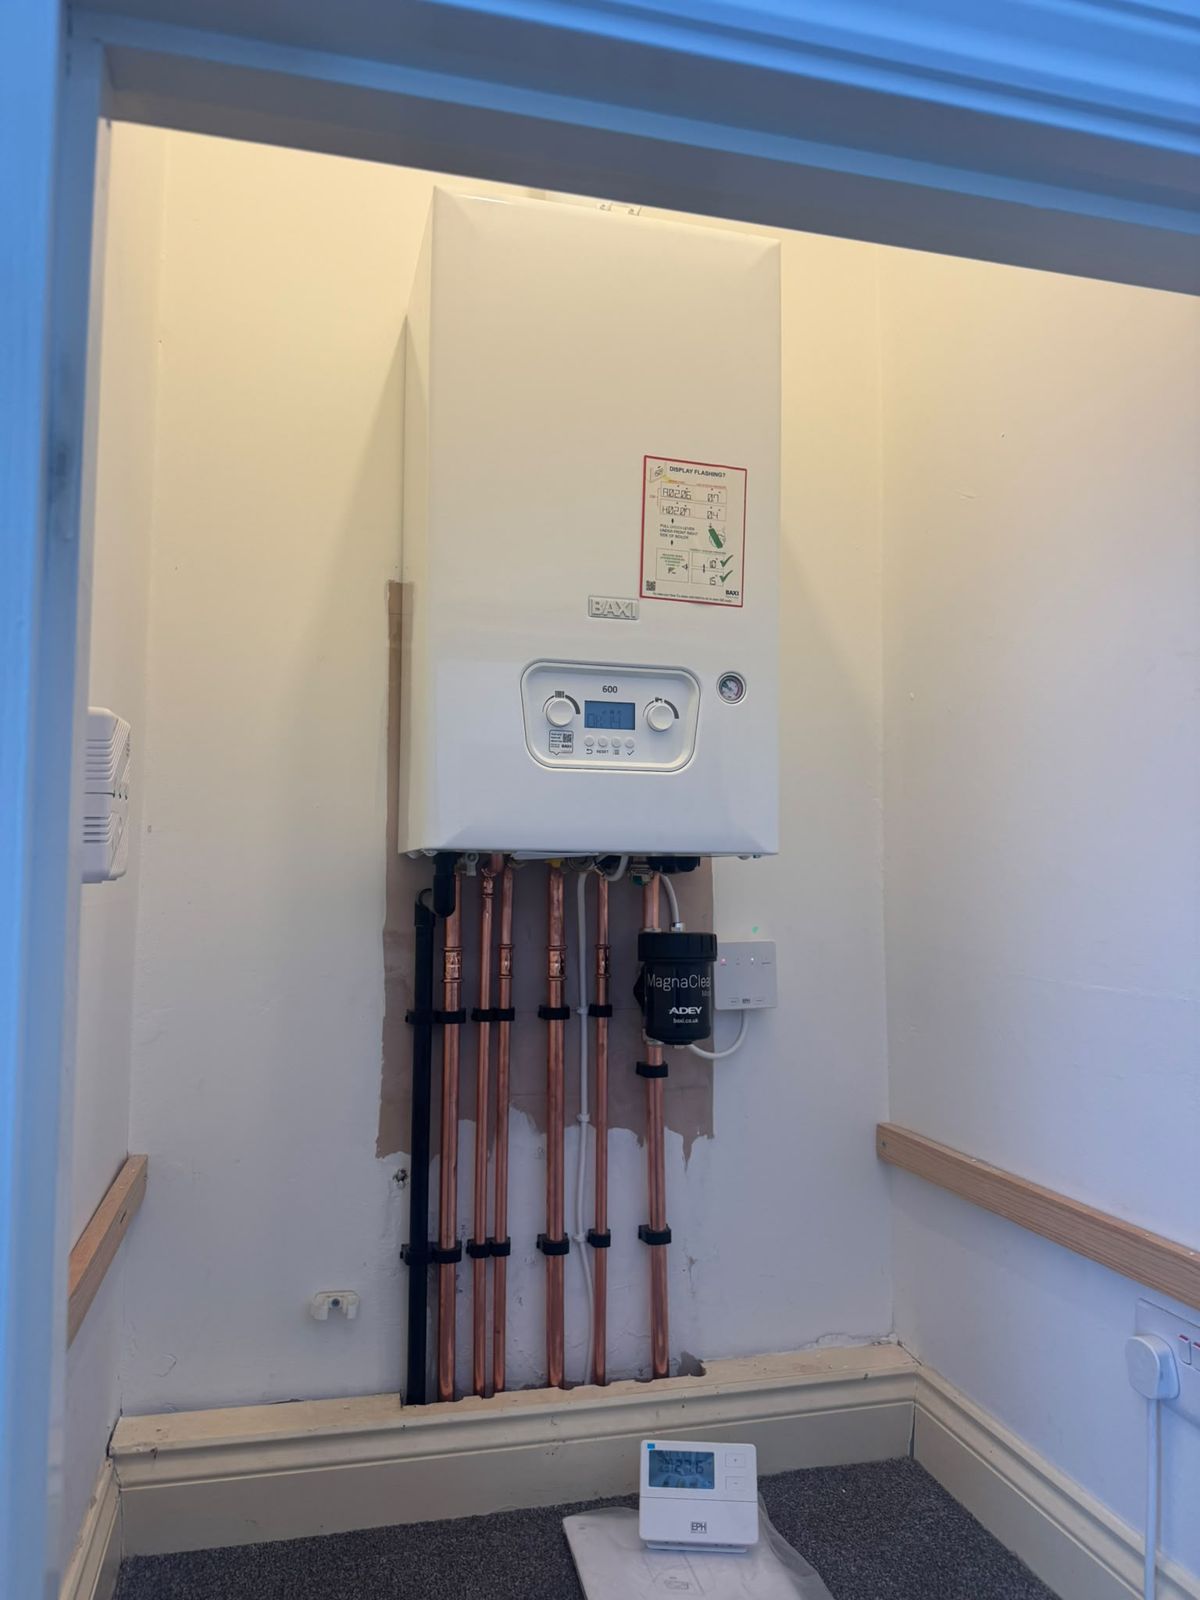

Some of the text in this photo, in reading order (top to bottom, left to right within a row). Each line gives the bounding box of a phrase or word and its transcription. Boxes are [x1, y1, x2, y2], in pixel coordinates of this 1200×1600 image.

[669, 466, 726, 478] DISPLAY FLASHING?
[590, 598, 637, 619] BAXI
[602, 685, 618, 693] 600
[647, 973, 711, 991] MagnaClea
[669, 1006, 702, 1014] ADEY
[691, 1521, 707, 1531] EPH
